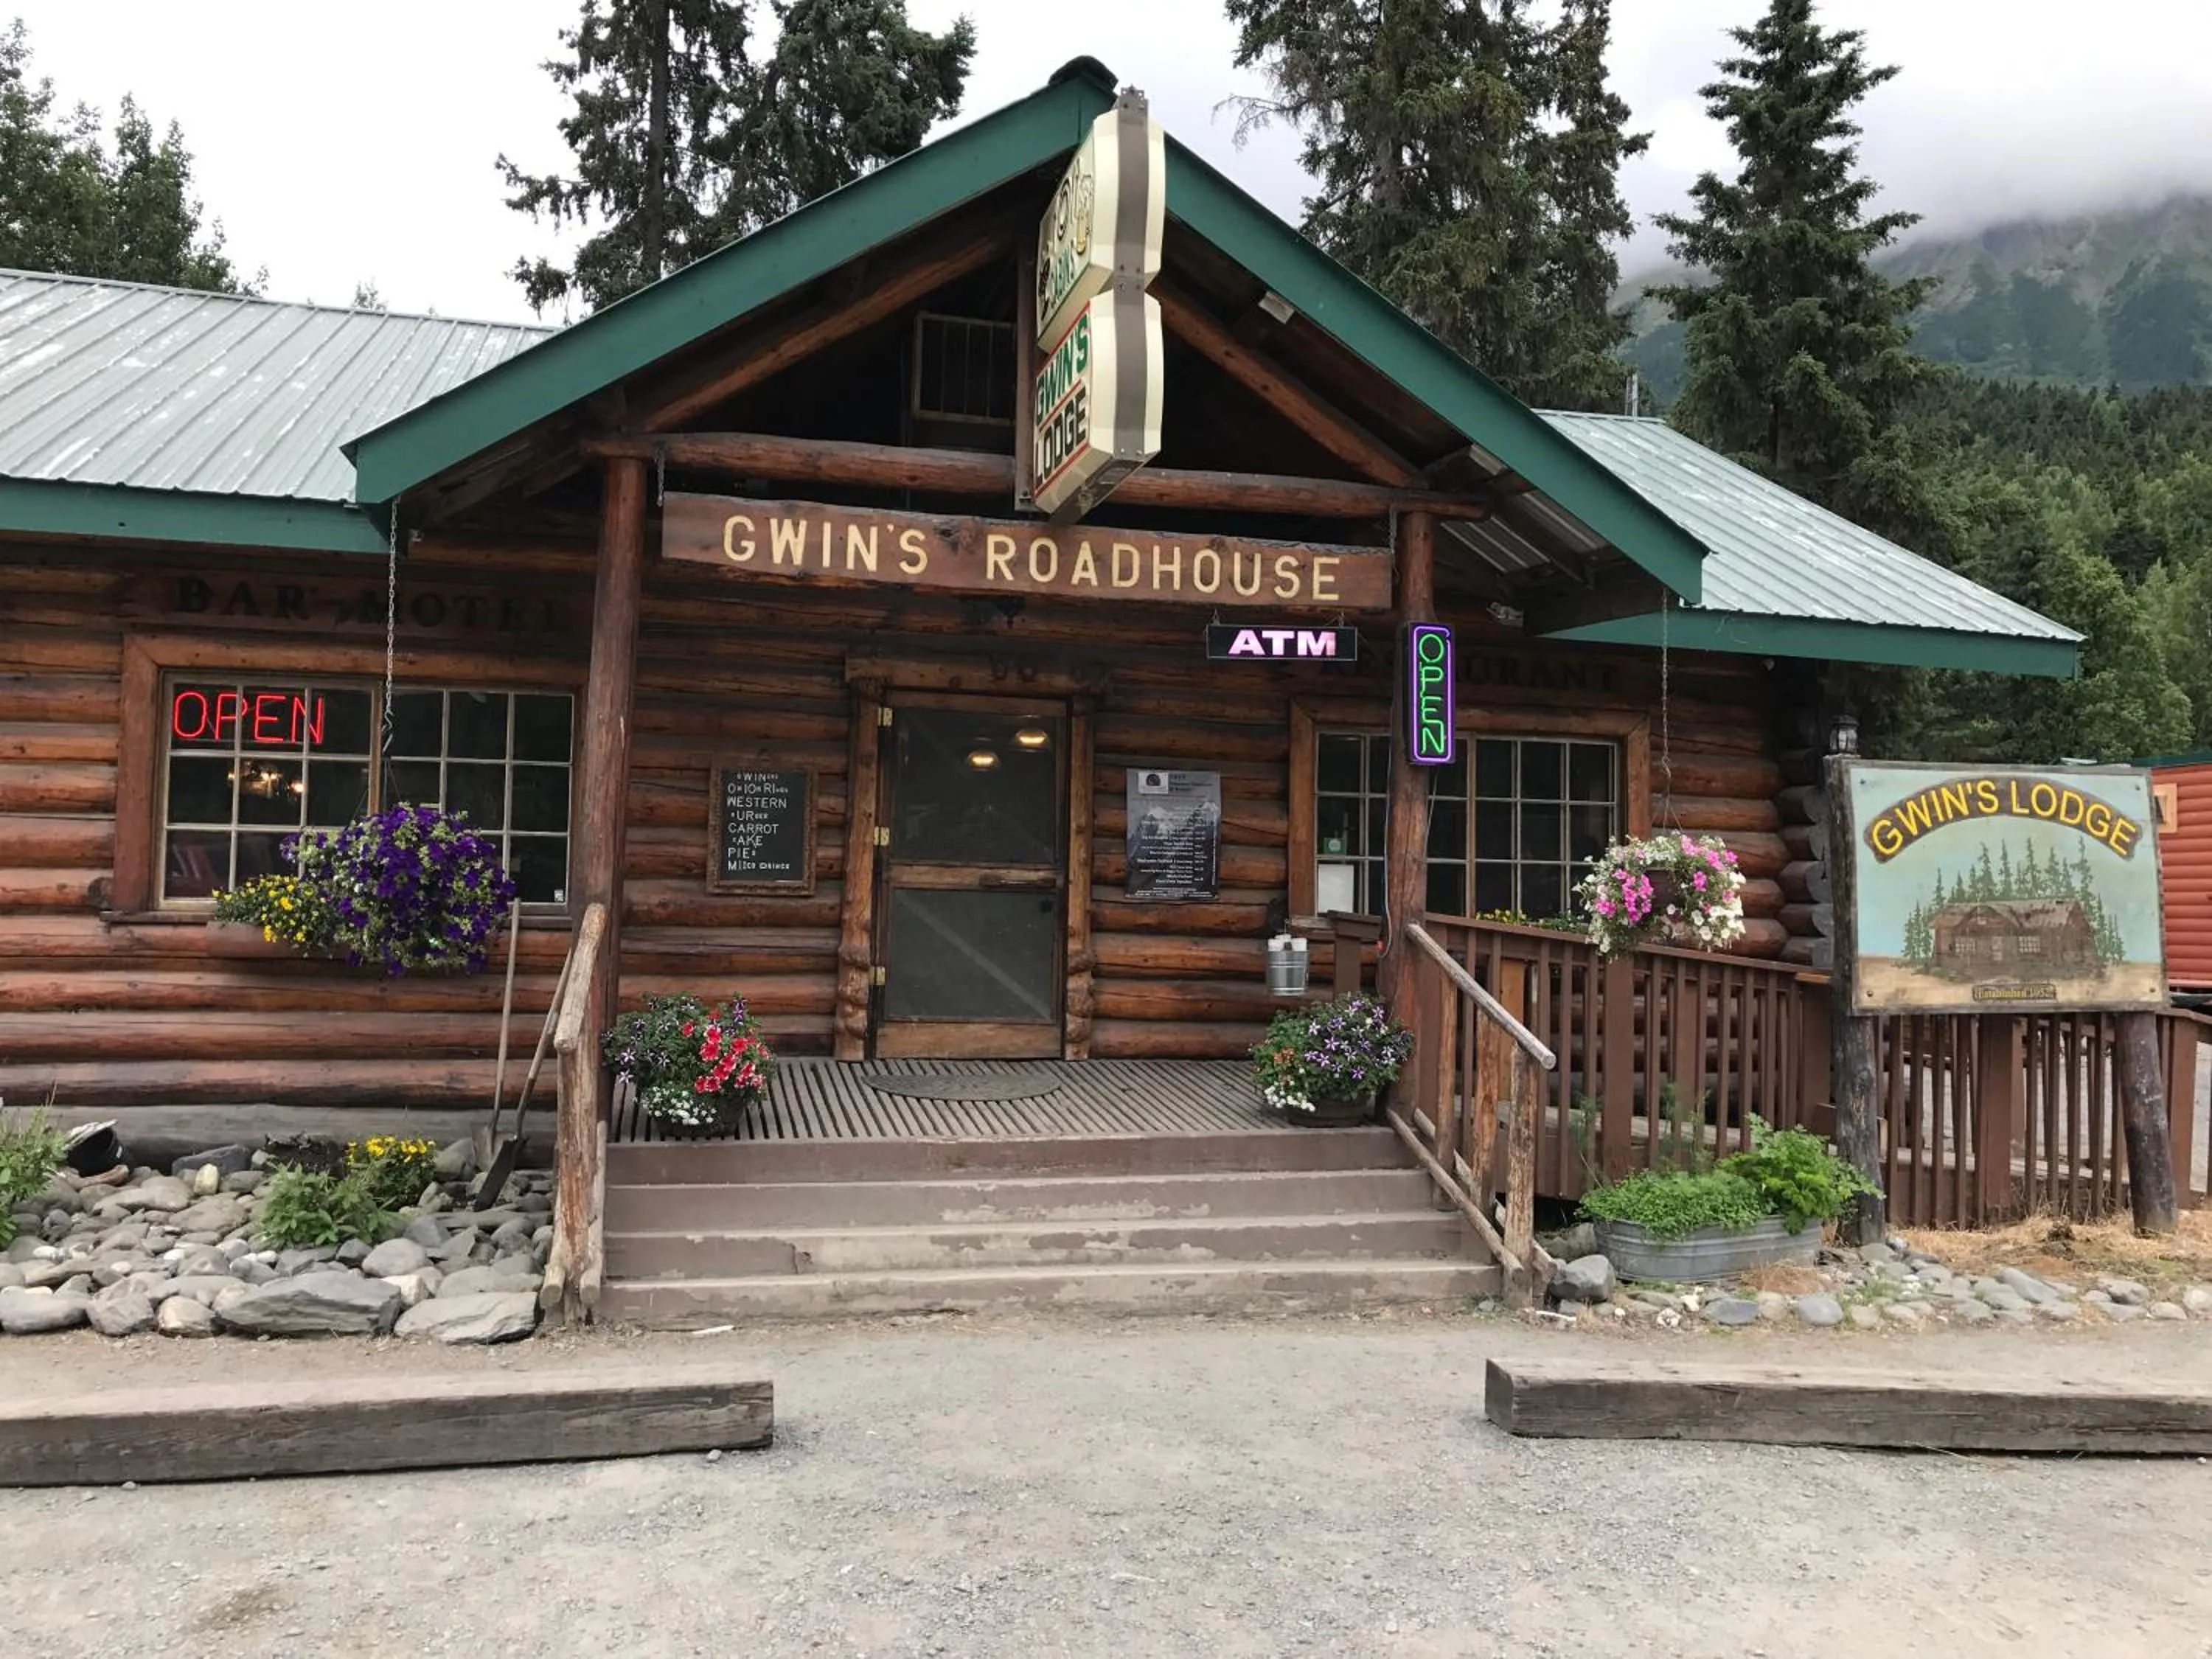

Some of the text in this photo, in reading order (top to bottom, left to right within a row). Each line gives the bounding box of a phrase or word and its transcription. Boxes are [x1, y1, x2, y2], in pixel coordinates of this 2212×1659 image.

[1037, 313, 1088, 428] GWIN'S
[1035, 385, 1086, 490] LODGE
[723, 515, 1341, 602] GWIN'S ROADHOUSE
[174, 575, 310, 621] BAR
[1228, 630, 1336, 656] ATM
[173, 690, 325, 745] OPEN
[1419, 632, 1445, 755] OPEN
[727, 797, 787, 809] WESTERN
[728, 823, 779, 835] CARROT
[1871, 779, 2137, 857] GWIN'S LODGE
